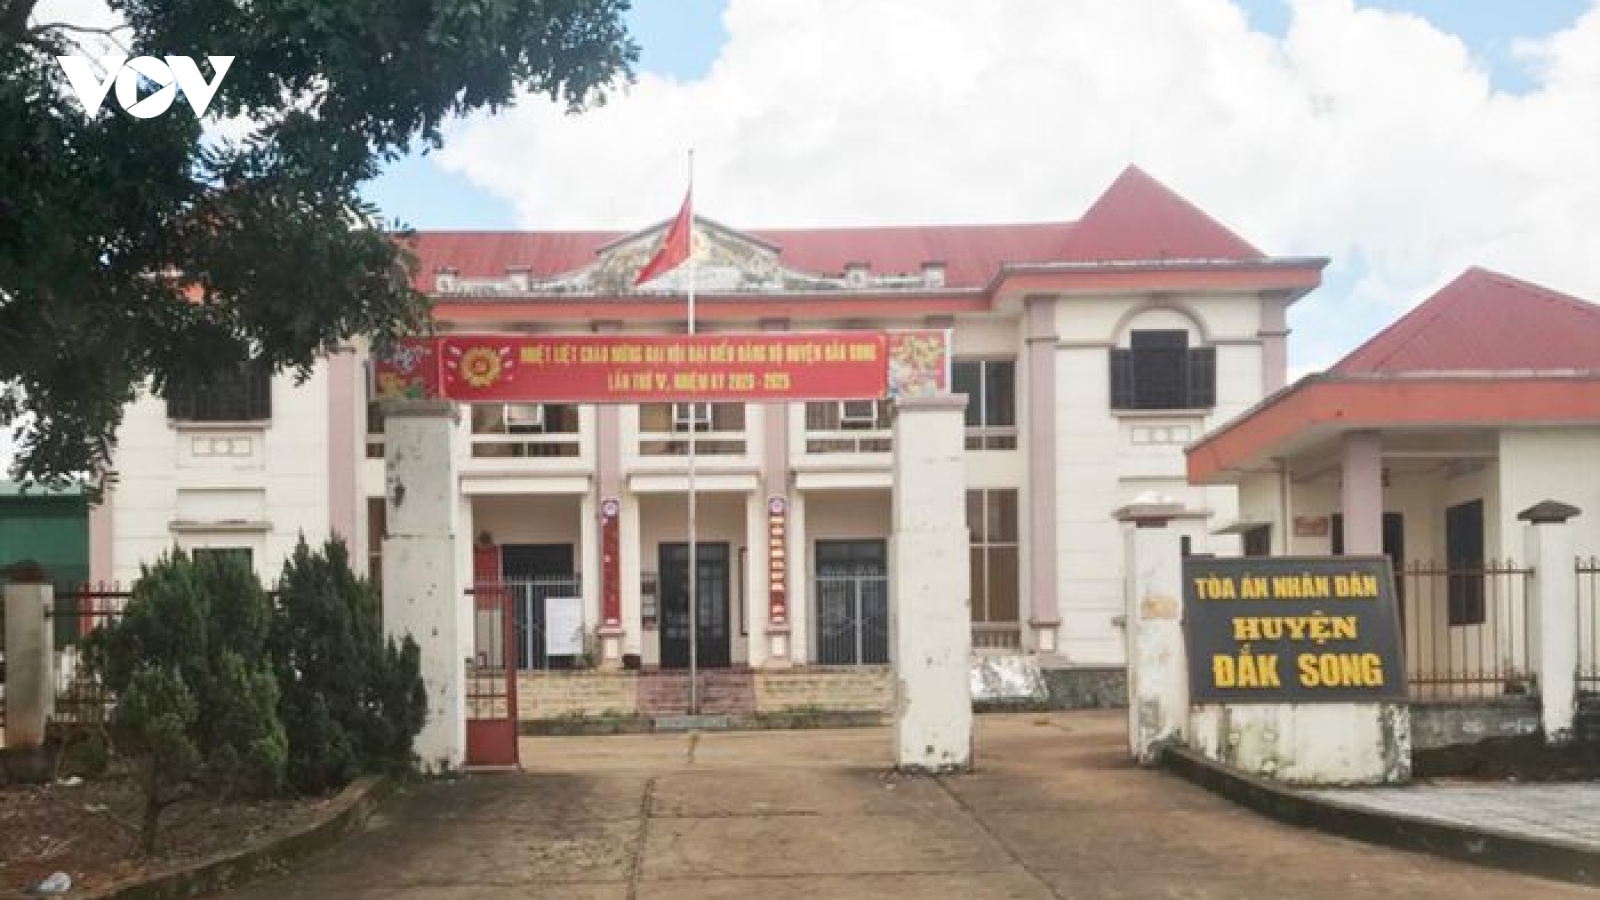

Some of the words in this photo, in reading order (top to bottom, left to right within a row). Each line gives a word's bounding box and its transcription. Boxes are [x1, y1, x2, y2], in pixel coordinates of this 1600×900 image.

[1194, 572, 1235, 599] TÒA
[1240, 572, 1269, 599] ÁN
[1272, 571, 1329, 599] NHÂN
[1334, 570, 1378, 597] DÂN
[1232, 610, 1358, 645] HUYỆN
[1212, 643, 1281, 687] ĐẮK
[1297, 652, 1384, 687] SONG
